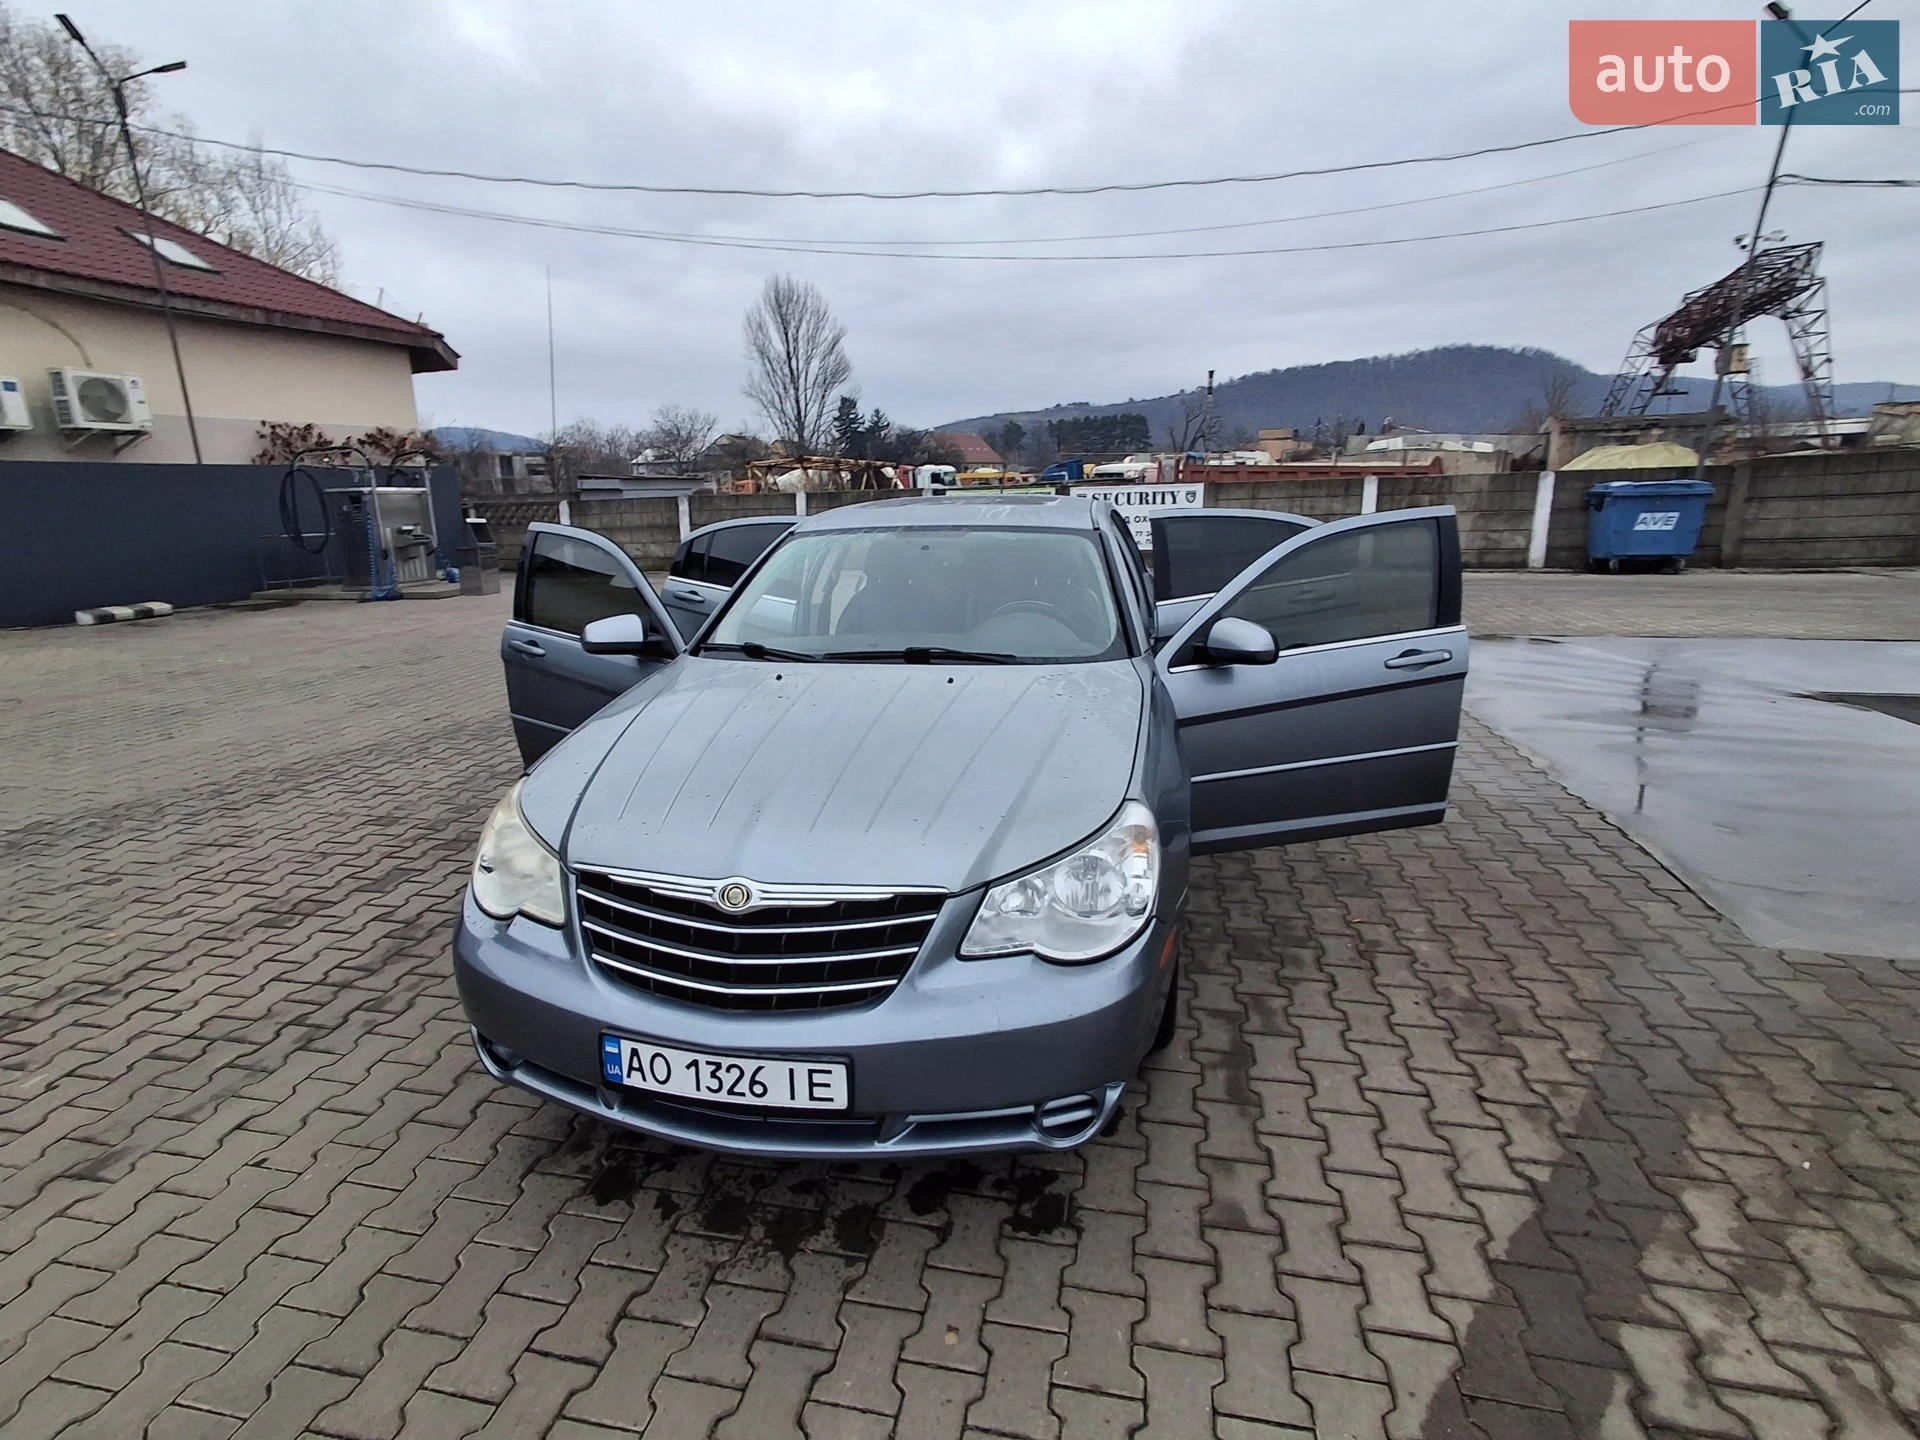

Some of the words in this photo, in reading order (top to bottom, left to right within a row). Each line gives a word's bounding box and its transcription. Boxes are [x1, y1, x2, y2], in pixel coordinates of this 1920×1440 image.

[1092, 490, 1180, 507] SECURITY
[1635, 515, 1677, 526] AVE
[607, 1062, 622, 1076] UA
[626, 1047, 672, 1085] AO
[685, 1058, 769, 1099] 1326
[788, 1067, 835, 1103] IE
